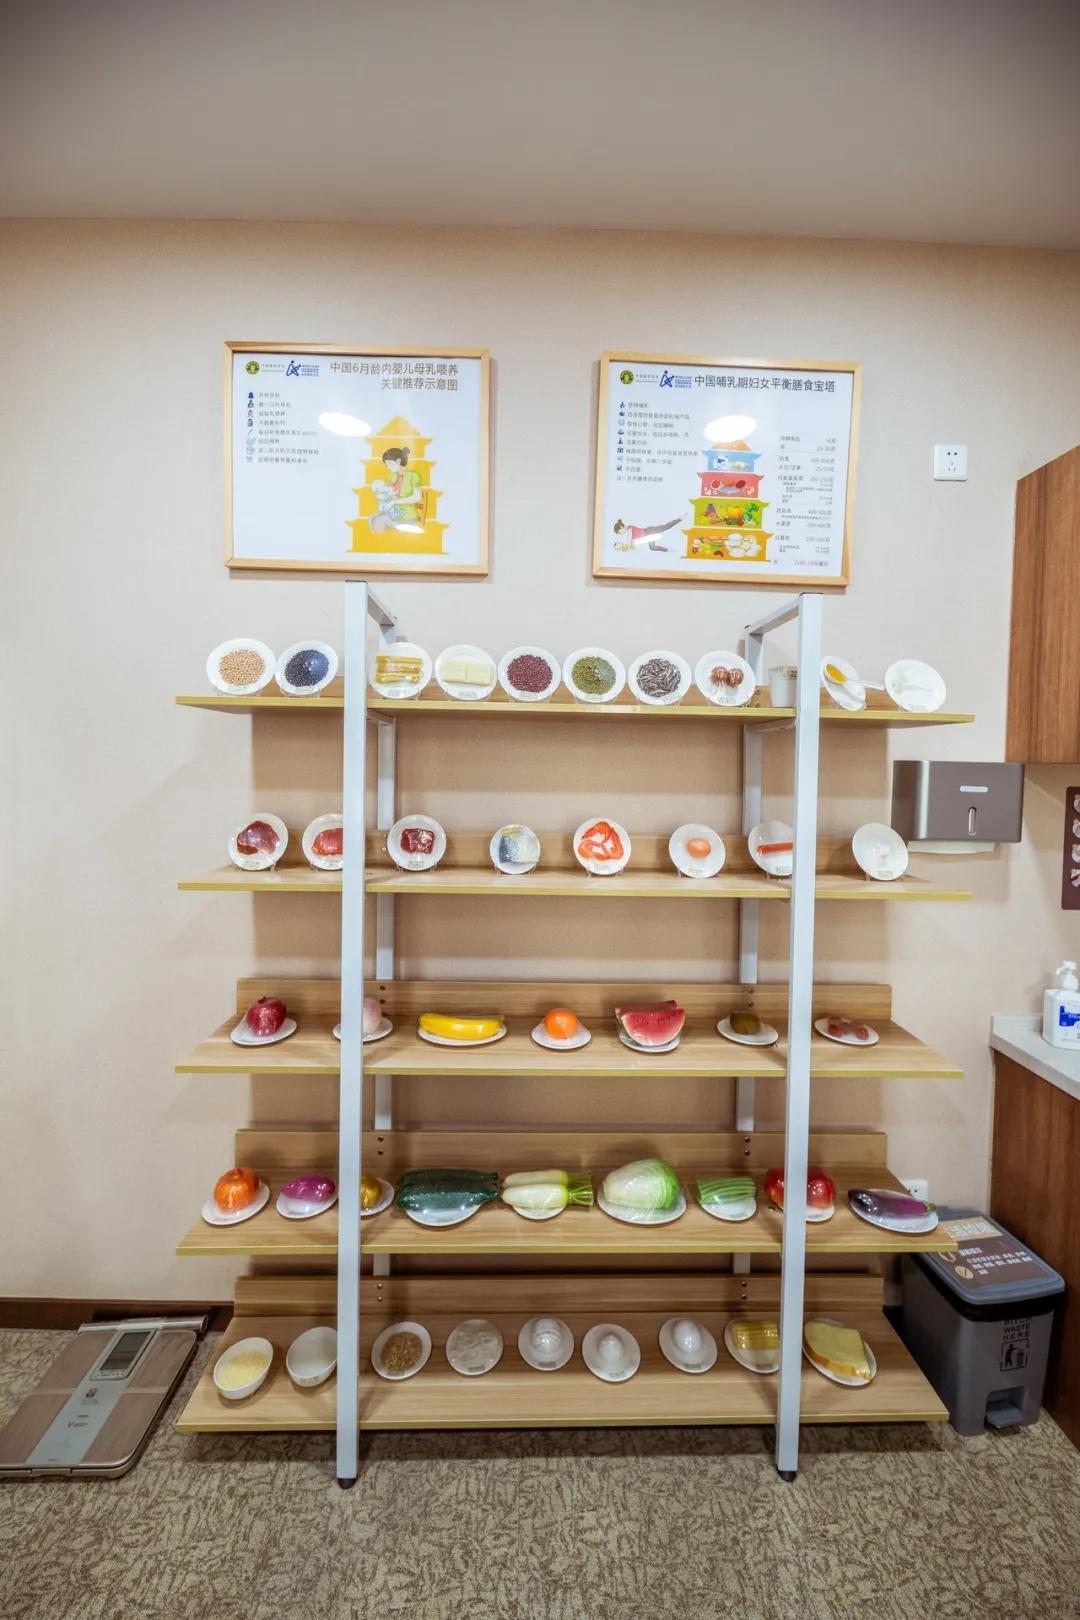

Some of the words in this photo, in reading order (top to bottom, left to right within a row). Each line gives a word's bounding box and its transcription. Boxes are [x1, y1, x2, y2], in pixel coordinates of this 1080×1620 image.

[330, 361, 458, 376] 中国6月龄内婴儿母乳喂养
[381, 377, 458, 391] 关键推荐示意图
[694, 374, 836, 393] 中国哺乳期妇女平衡膳食宝塔
[1003, 1323, 1030, 1333] WASTE
[1003, 1330, 1030, 1341] HERE
